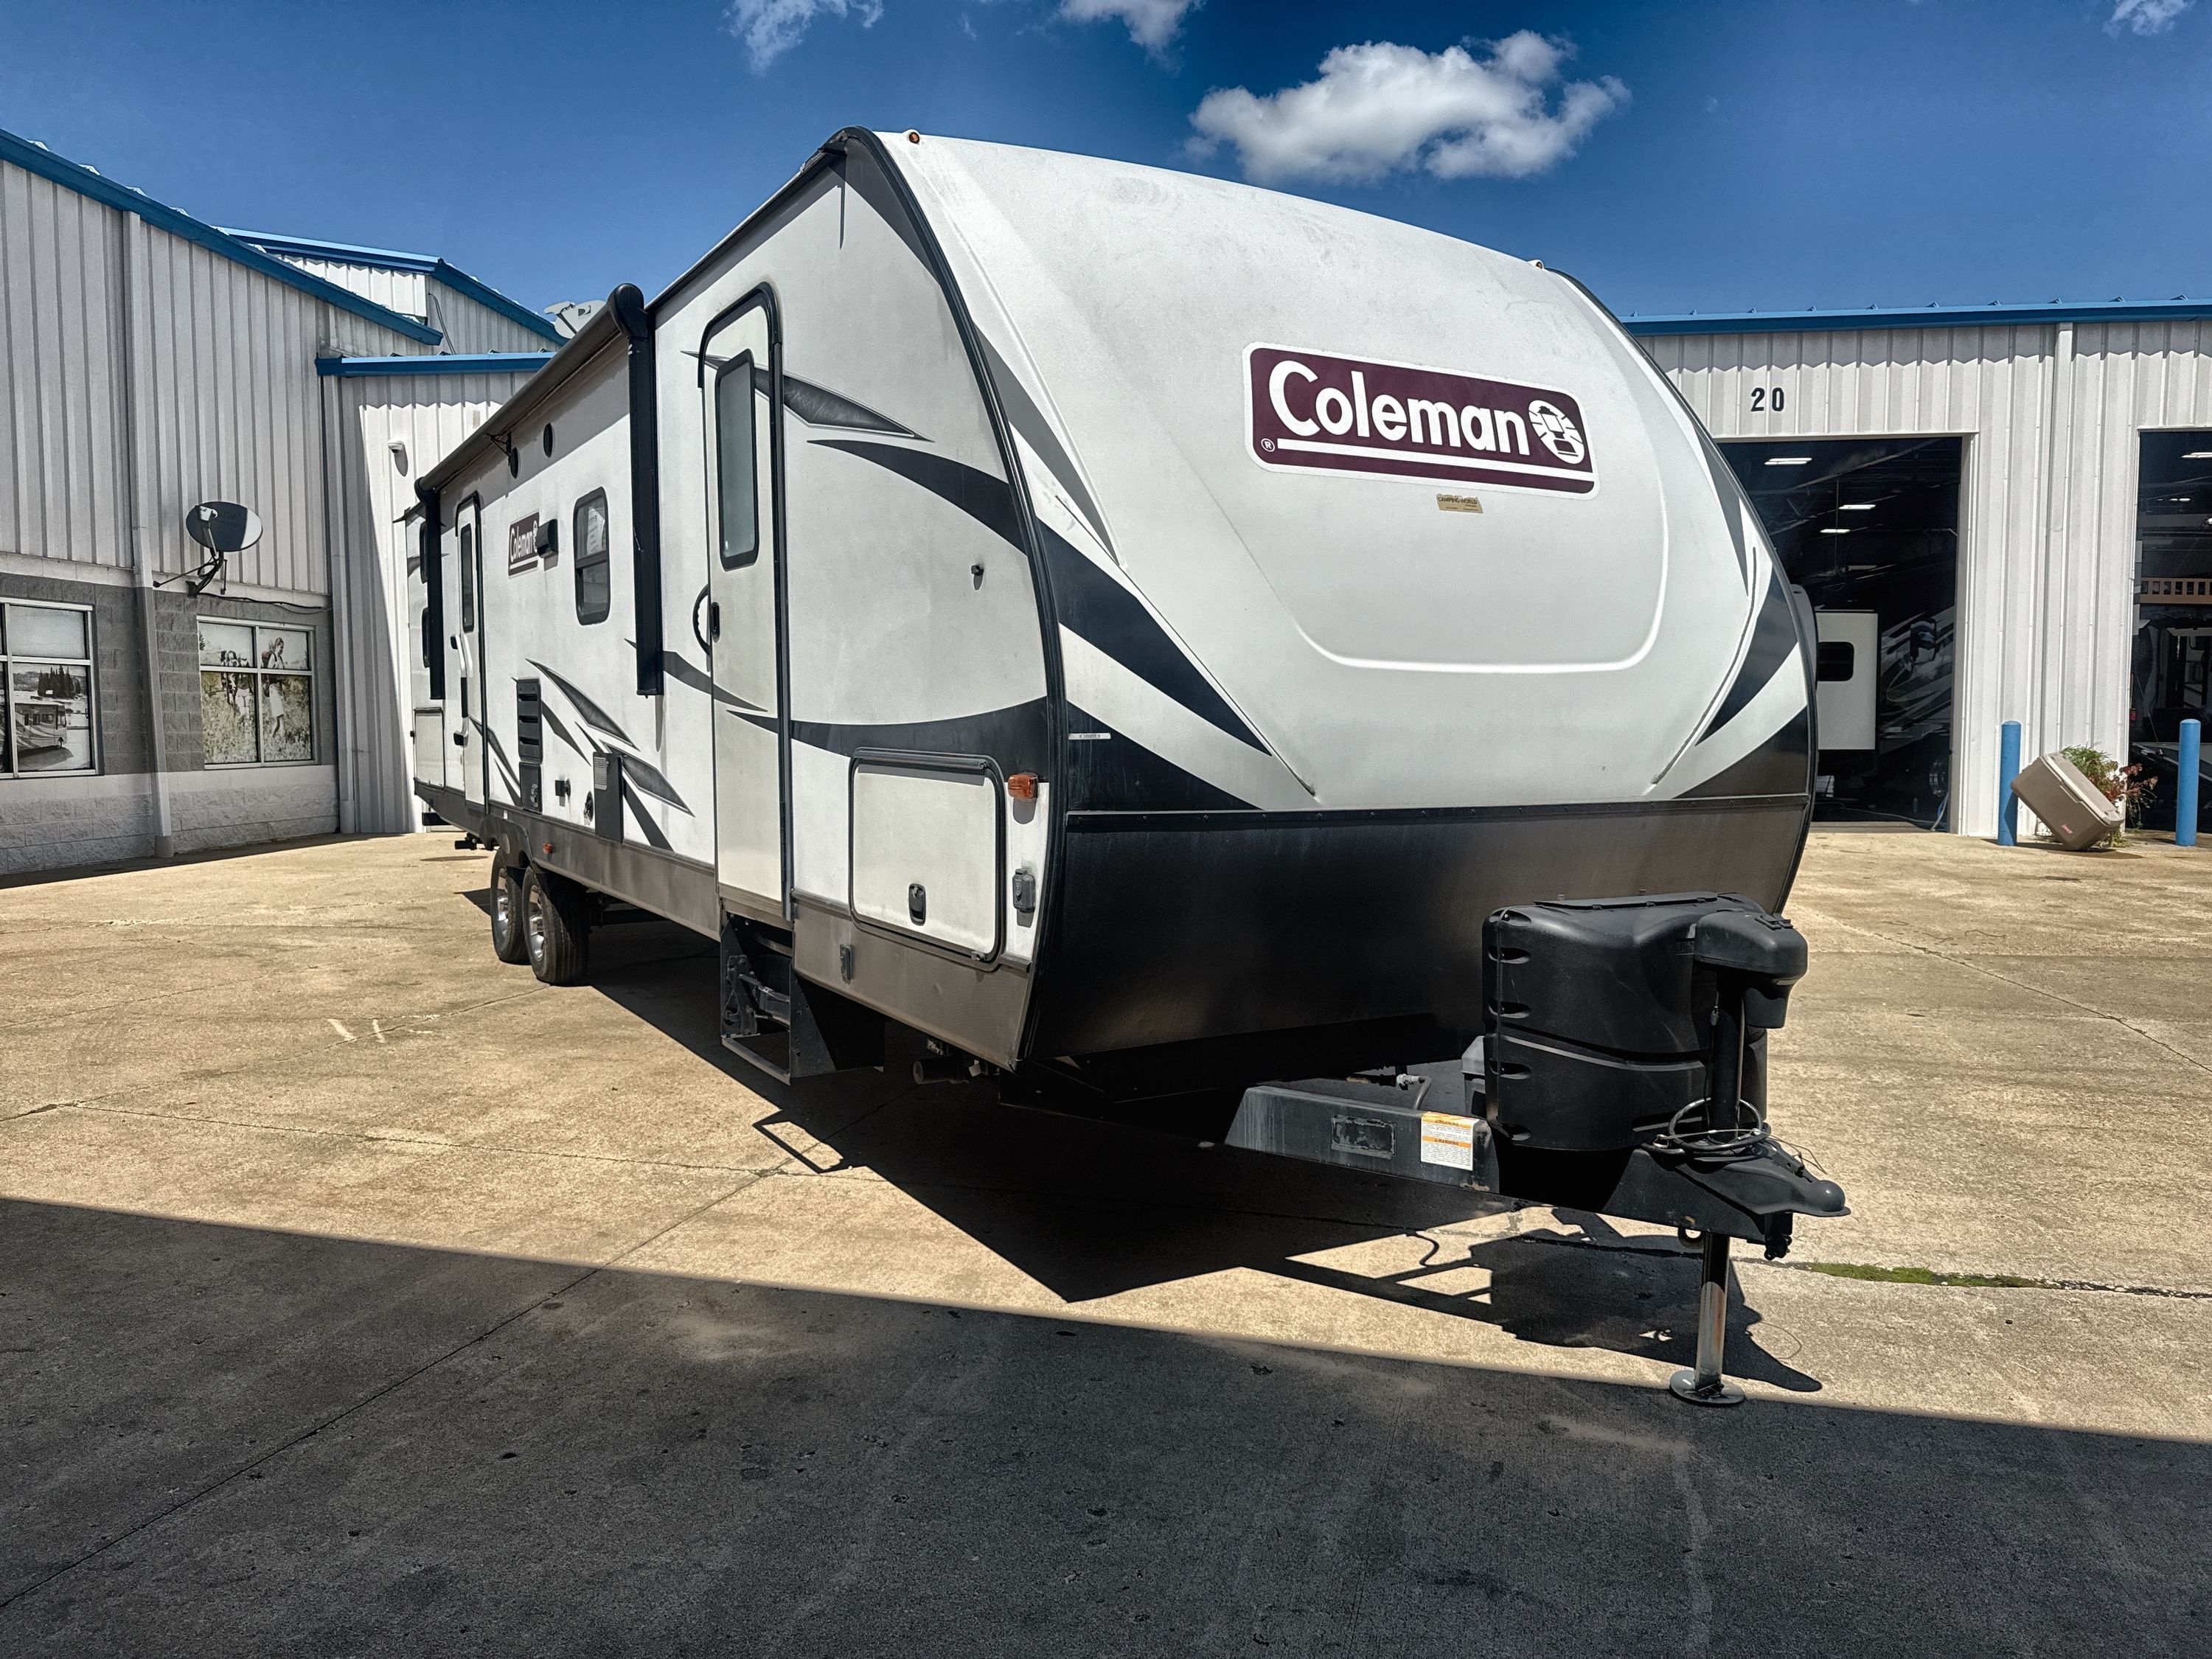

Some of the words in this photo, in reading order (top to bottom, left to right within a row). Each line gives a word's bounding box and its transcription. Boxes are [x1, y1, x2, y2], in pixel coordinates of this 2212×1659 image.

[1269, 360, 1531, 456] Coleman
[1750, 387, 1784, 411] 20
[509, 525, 533, 563] Coleman
